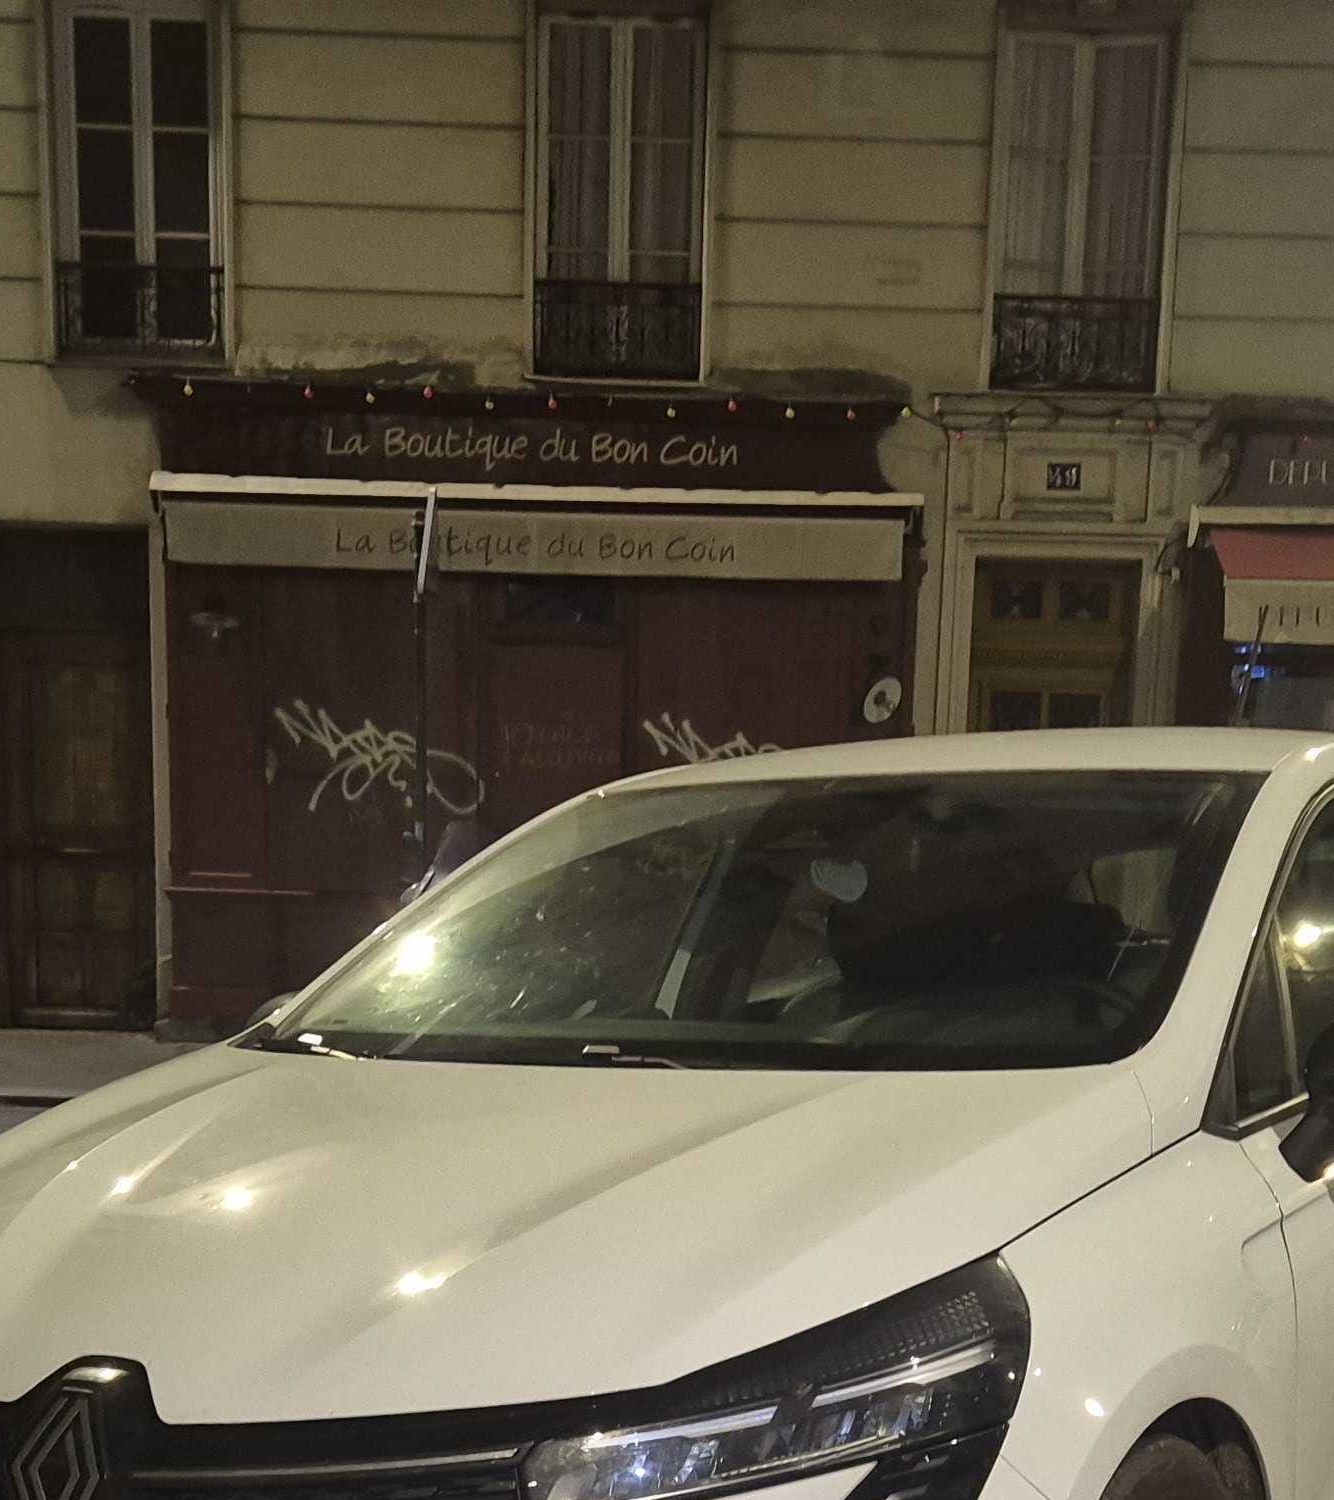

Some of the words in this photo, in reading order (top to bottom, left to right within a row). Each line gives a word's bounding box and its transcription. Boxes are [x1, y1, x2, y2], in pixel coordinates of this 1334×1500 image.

[325, 427, 369, 457] La
[384, 428, 528, 470] Boutique
[539, 427, 579, 463] du
[591, 435, 649, 465] Bon
[660, 435, 739, 467] Coin
[335, 528, 375, 553] La
[389, 527, 531, 566] Btique
[547, 529, 584, 557] du
[598, 533, 653, 558] Bon
[666, 536, 735, 562] Coin
